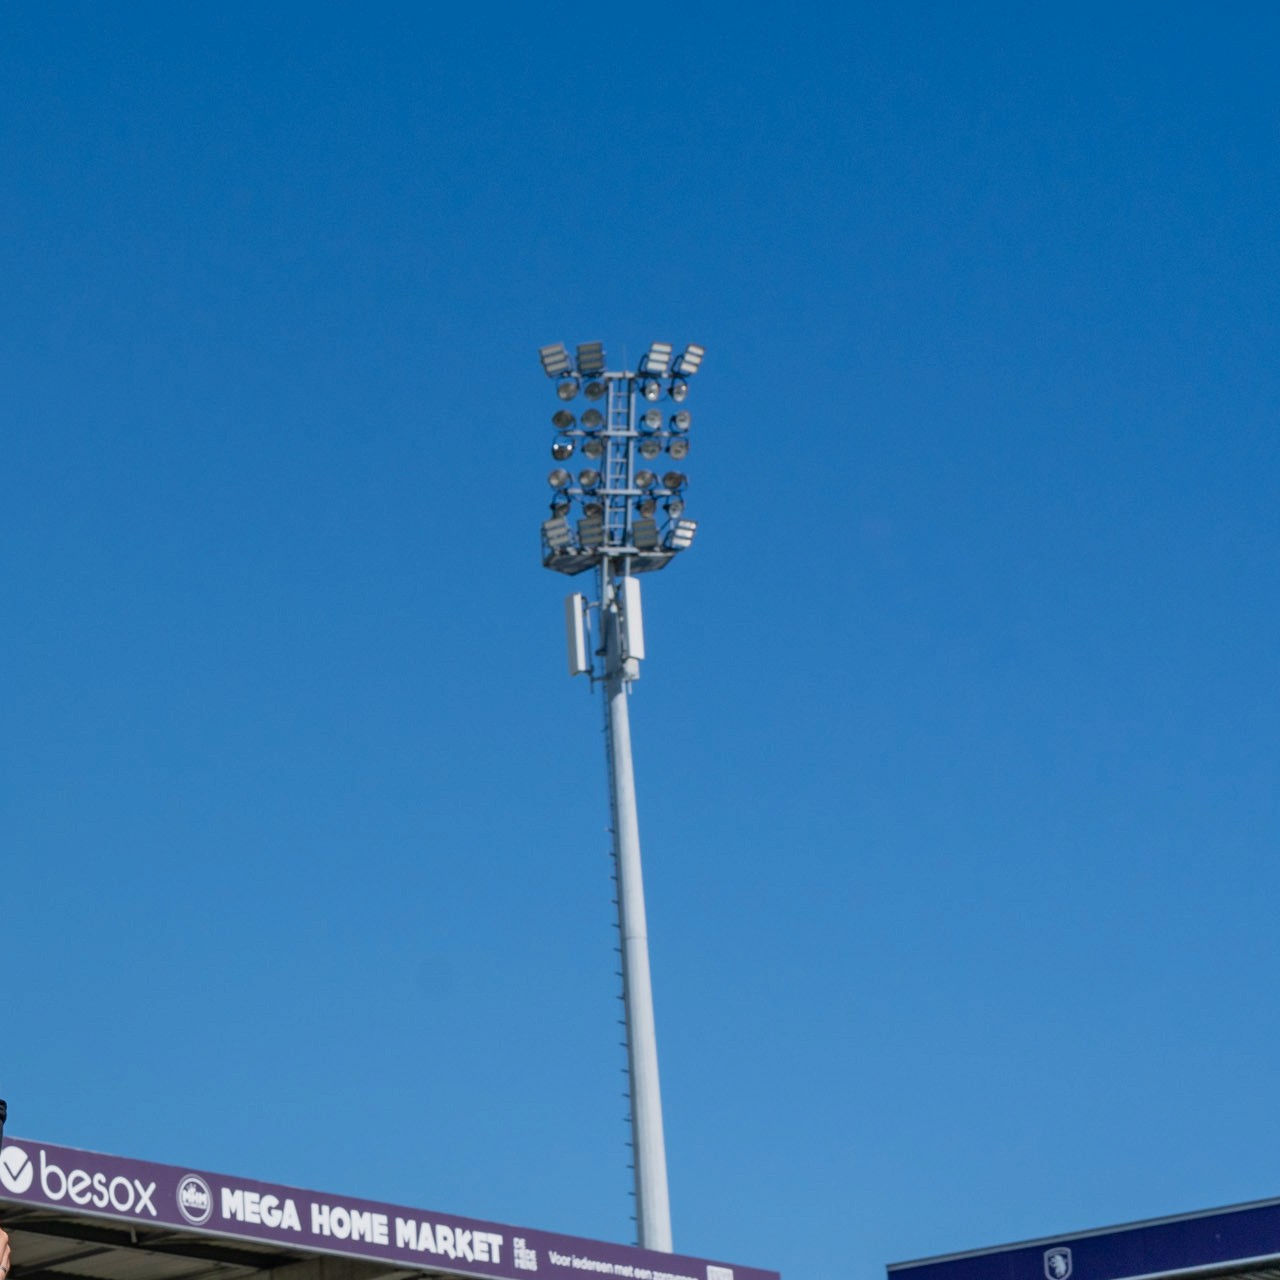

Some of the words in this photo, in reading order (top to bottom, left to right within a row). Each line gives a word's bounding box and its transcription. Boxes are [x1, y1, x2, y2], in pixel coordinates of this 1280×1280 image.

[40, 1149, 158, 1217] besox
[222, 1187, 301, 1233] MEGA
[310, 1202, 389, 1246] HOME
[395, 1217, 504, 1265] MARKET
[548, 1250, 571, 1267] Voor
